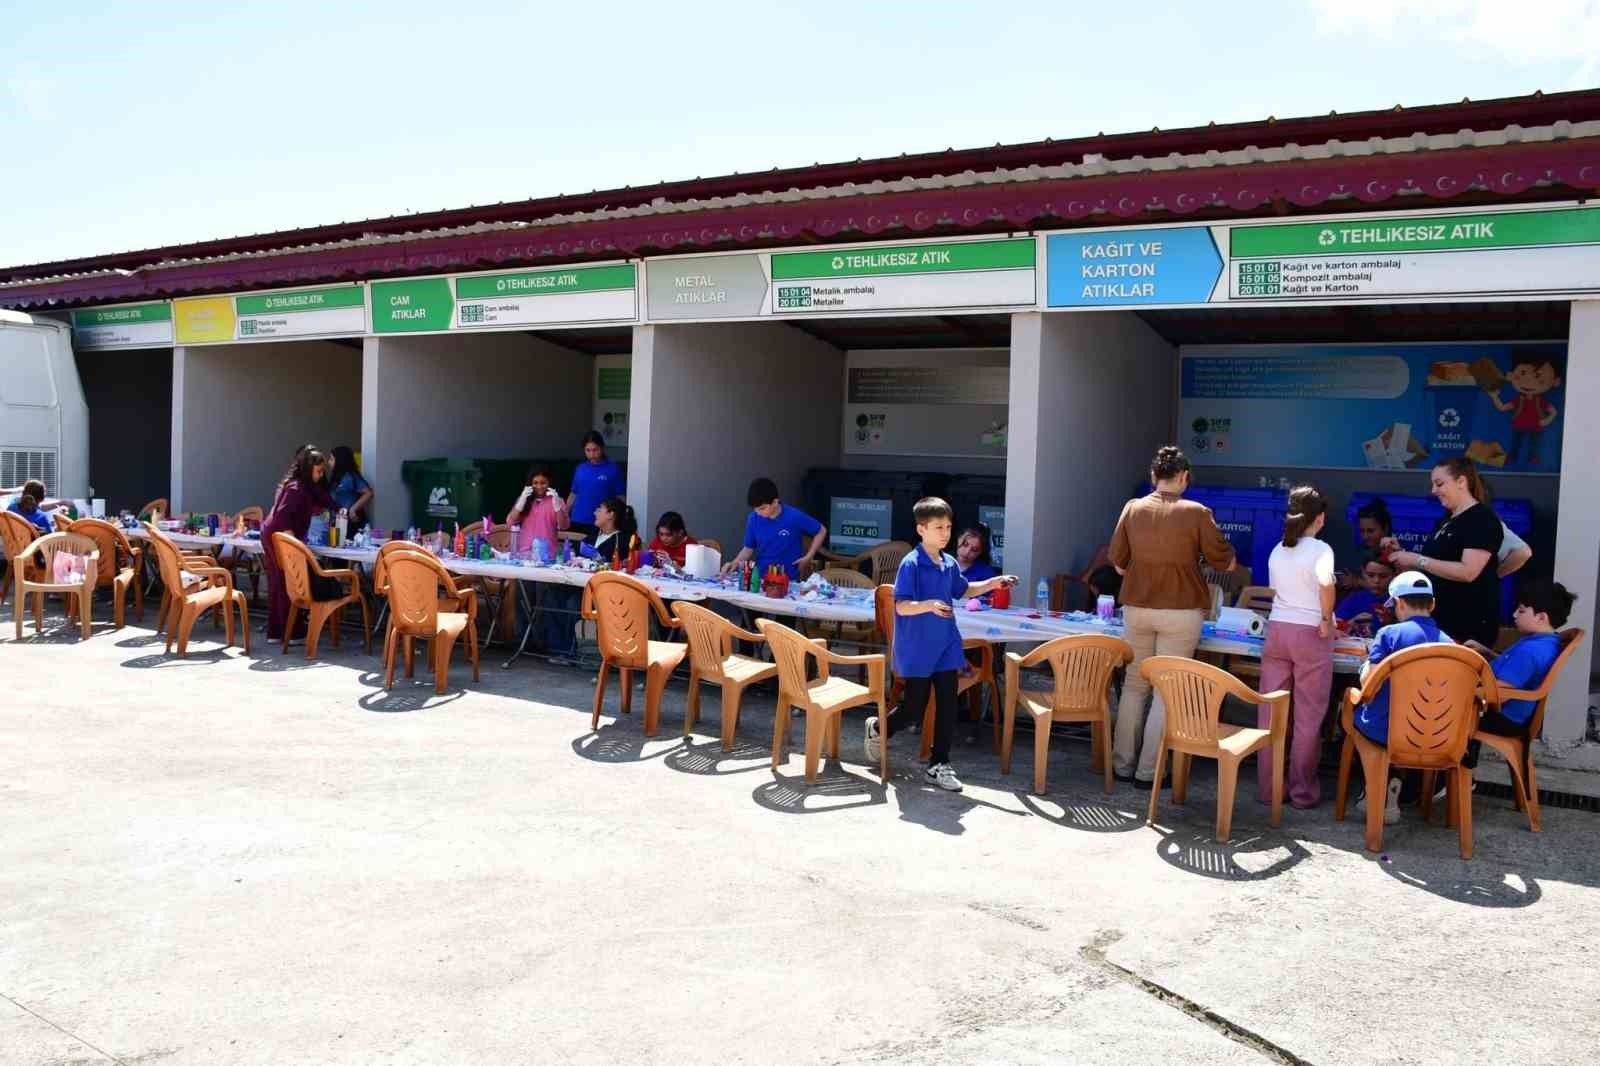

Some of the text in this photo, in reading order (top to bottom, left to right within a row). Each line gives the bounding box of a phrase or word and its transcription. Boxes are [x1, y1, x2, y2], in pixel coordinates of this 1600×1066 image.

[1450, 223, 1494, 239] ATIK
[1082, 241, 1162, 258] KAĞIT VE
[921, 251, 951, 264] ATIK
[1082, 263, 1155, 278] KARTON
[1240, 264, 1252, 273] 15
[1254, 264, 1265, 272] 01
[1267, 263, 1279, 272] 01
[1325, 261, 1358, 269] karton
[1360, 259, 1401, 270] ambalaj
[557, 274, 578, 286] ATIK
[675, 276, 716, 288] METAL
[1240, 272, 1372, 284] 15 01 05 Kompozit ambalaj
[780, 289, 789, 297] 15
[790, 288, 799, 296] 01
[812, 288, 842, 296] Metalik
[843, 286, 875, 295] ambalaj
[1082, 284, 1155, 298] ATIKLAR
[1240, 286, 1252, 294] 20
[1254, 285, 1265, 293] 01
[1267, 284, 1279, 293] 01
[1325, 283, 1359, 292] Karton
[390, 296, 410, 306] CAM
[675, 292, 727, 304] ATIKLAR
[780, 297, 844, 307] 20 01 40 Metaller
[391, 308, 426, 320] ATIKLAR
[854, 526, 864, 535] 01
[867, 527, 878, 536] 40
